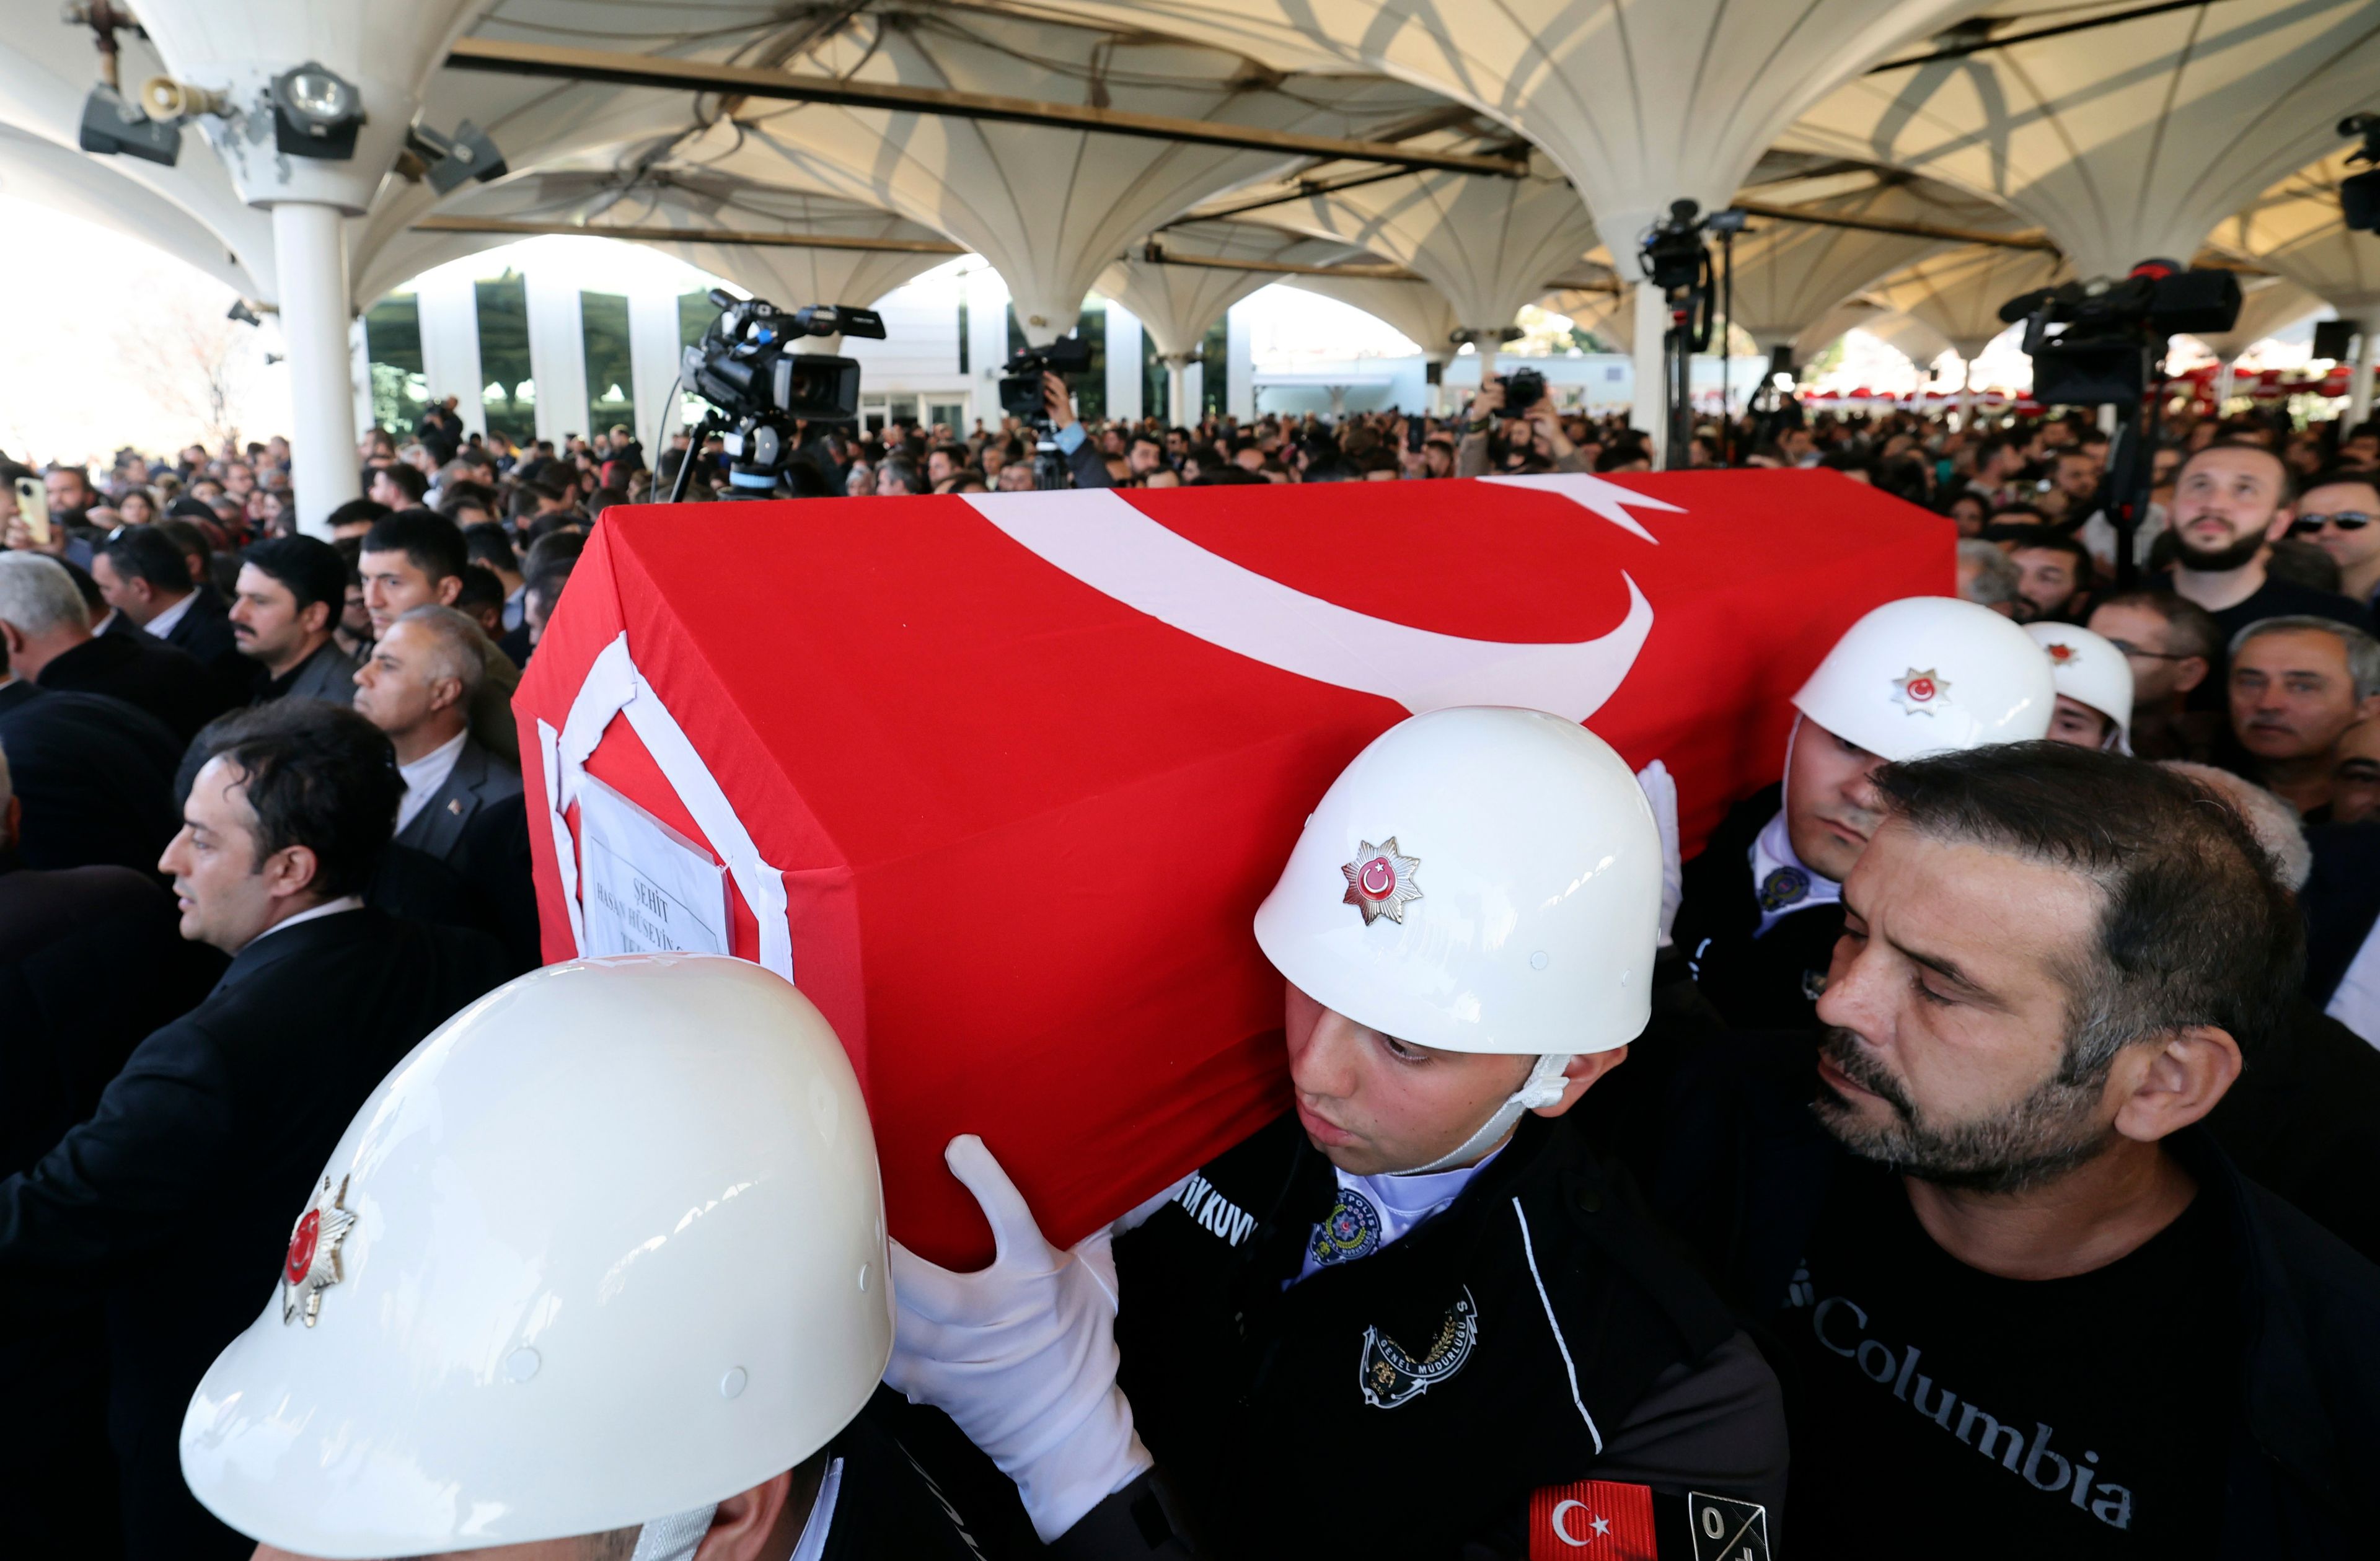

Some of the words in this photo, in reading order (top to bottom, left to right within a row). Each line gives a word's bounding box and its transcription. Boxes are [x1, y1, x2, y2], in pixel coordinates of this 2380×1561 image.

[597, 882, 625, 918] HASAN
[628, 907, 673, 951] HÜSEYİN
[633, 877, 668, 923] ŞEHİT
[1380, 1339, 1411, 1372] GENEL
[1418, 1321, 1467, 1374] MÜDÜRLÜĞÜ
[1813, 1296, 2133, 1529] Columbia
